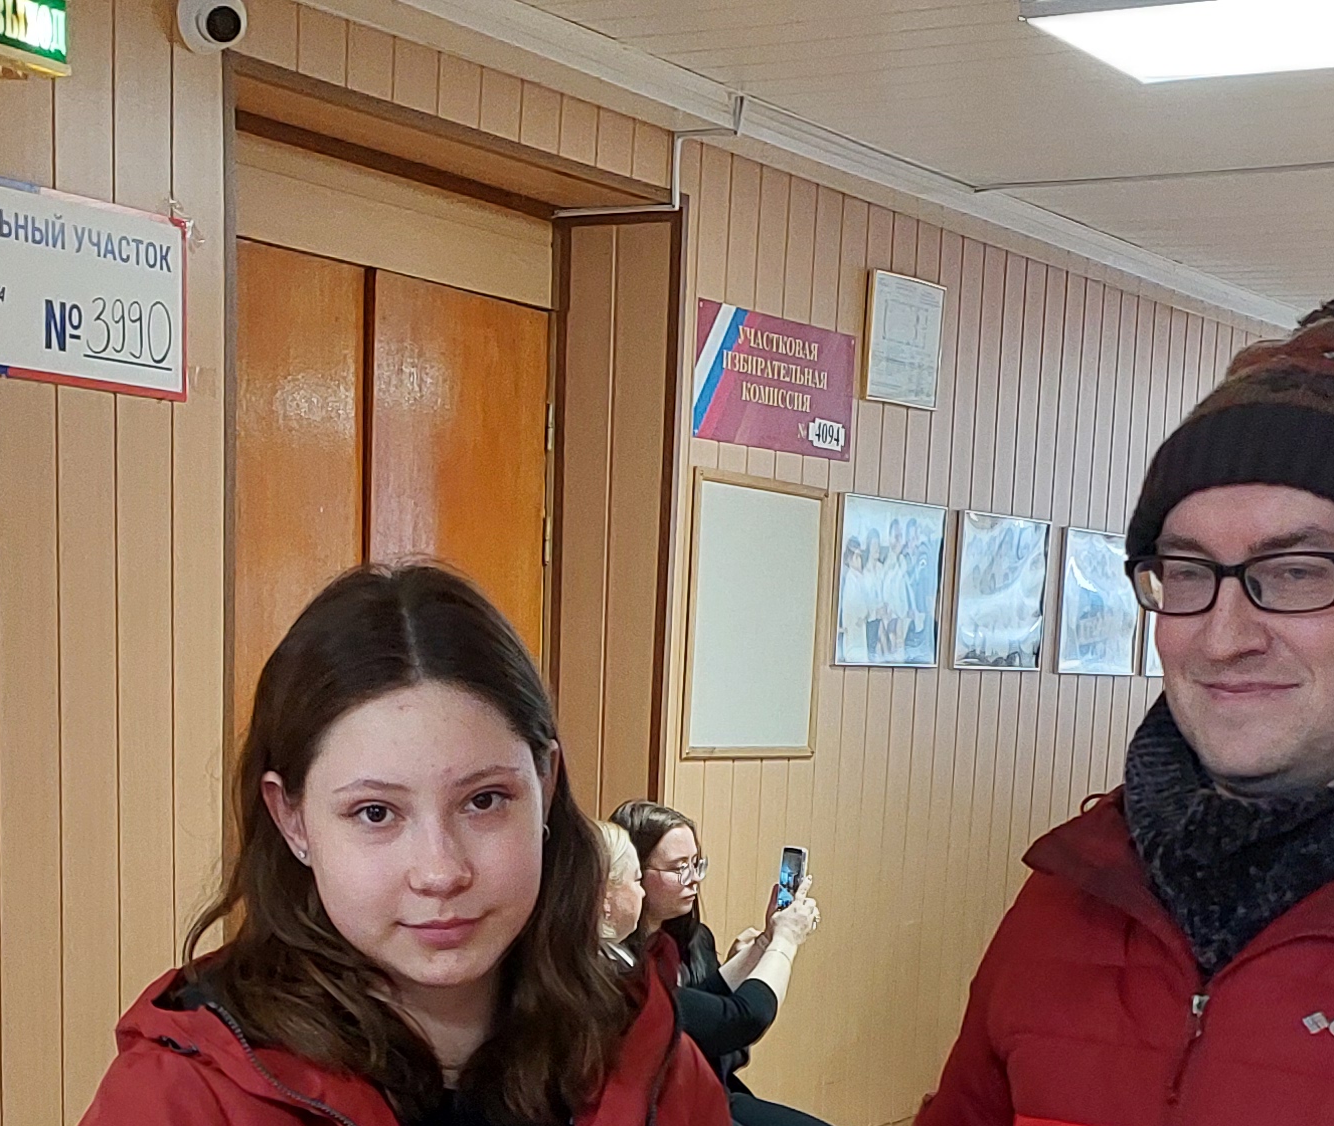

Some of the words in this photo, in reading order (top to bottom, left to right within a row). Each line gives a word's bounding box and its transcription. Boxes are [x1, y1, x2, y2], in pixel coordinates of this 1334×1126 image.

[72, 224, 172, 273] УЧАСТОК
[44, 298, 82, 352] №
[86, 297, 172, 364] 3990
[737, 325, 819, 362] УЧАСТКОВАЯ
[722, 349, 828, 391] ИЗБИРАТЕЛЬНАЯ
[741, 381, 812, 413] КОМИССИЯ
[814, 421, 841, 447] 4094
